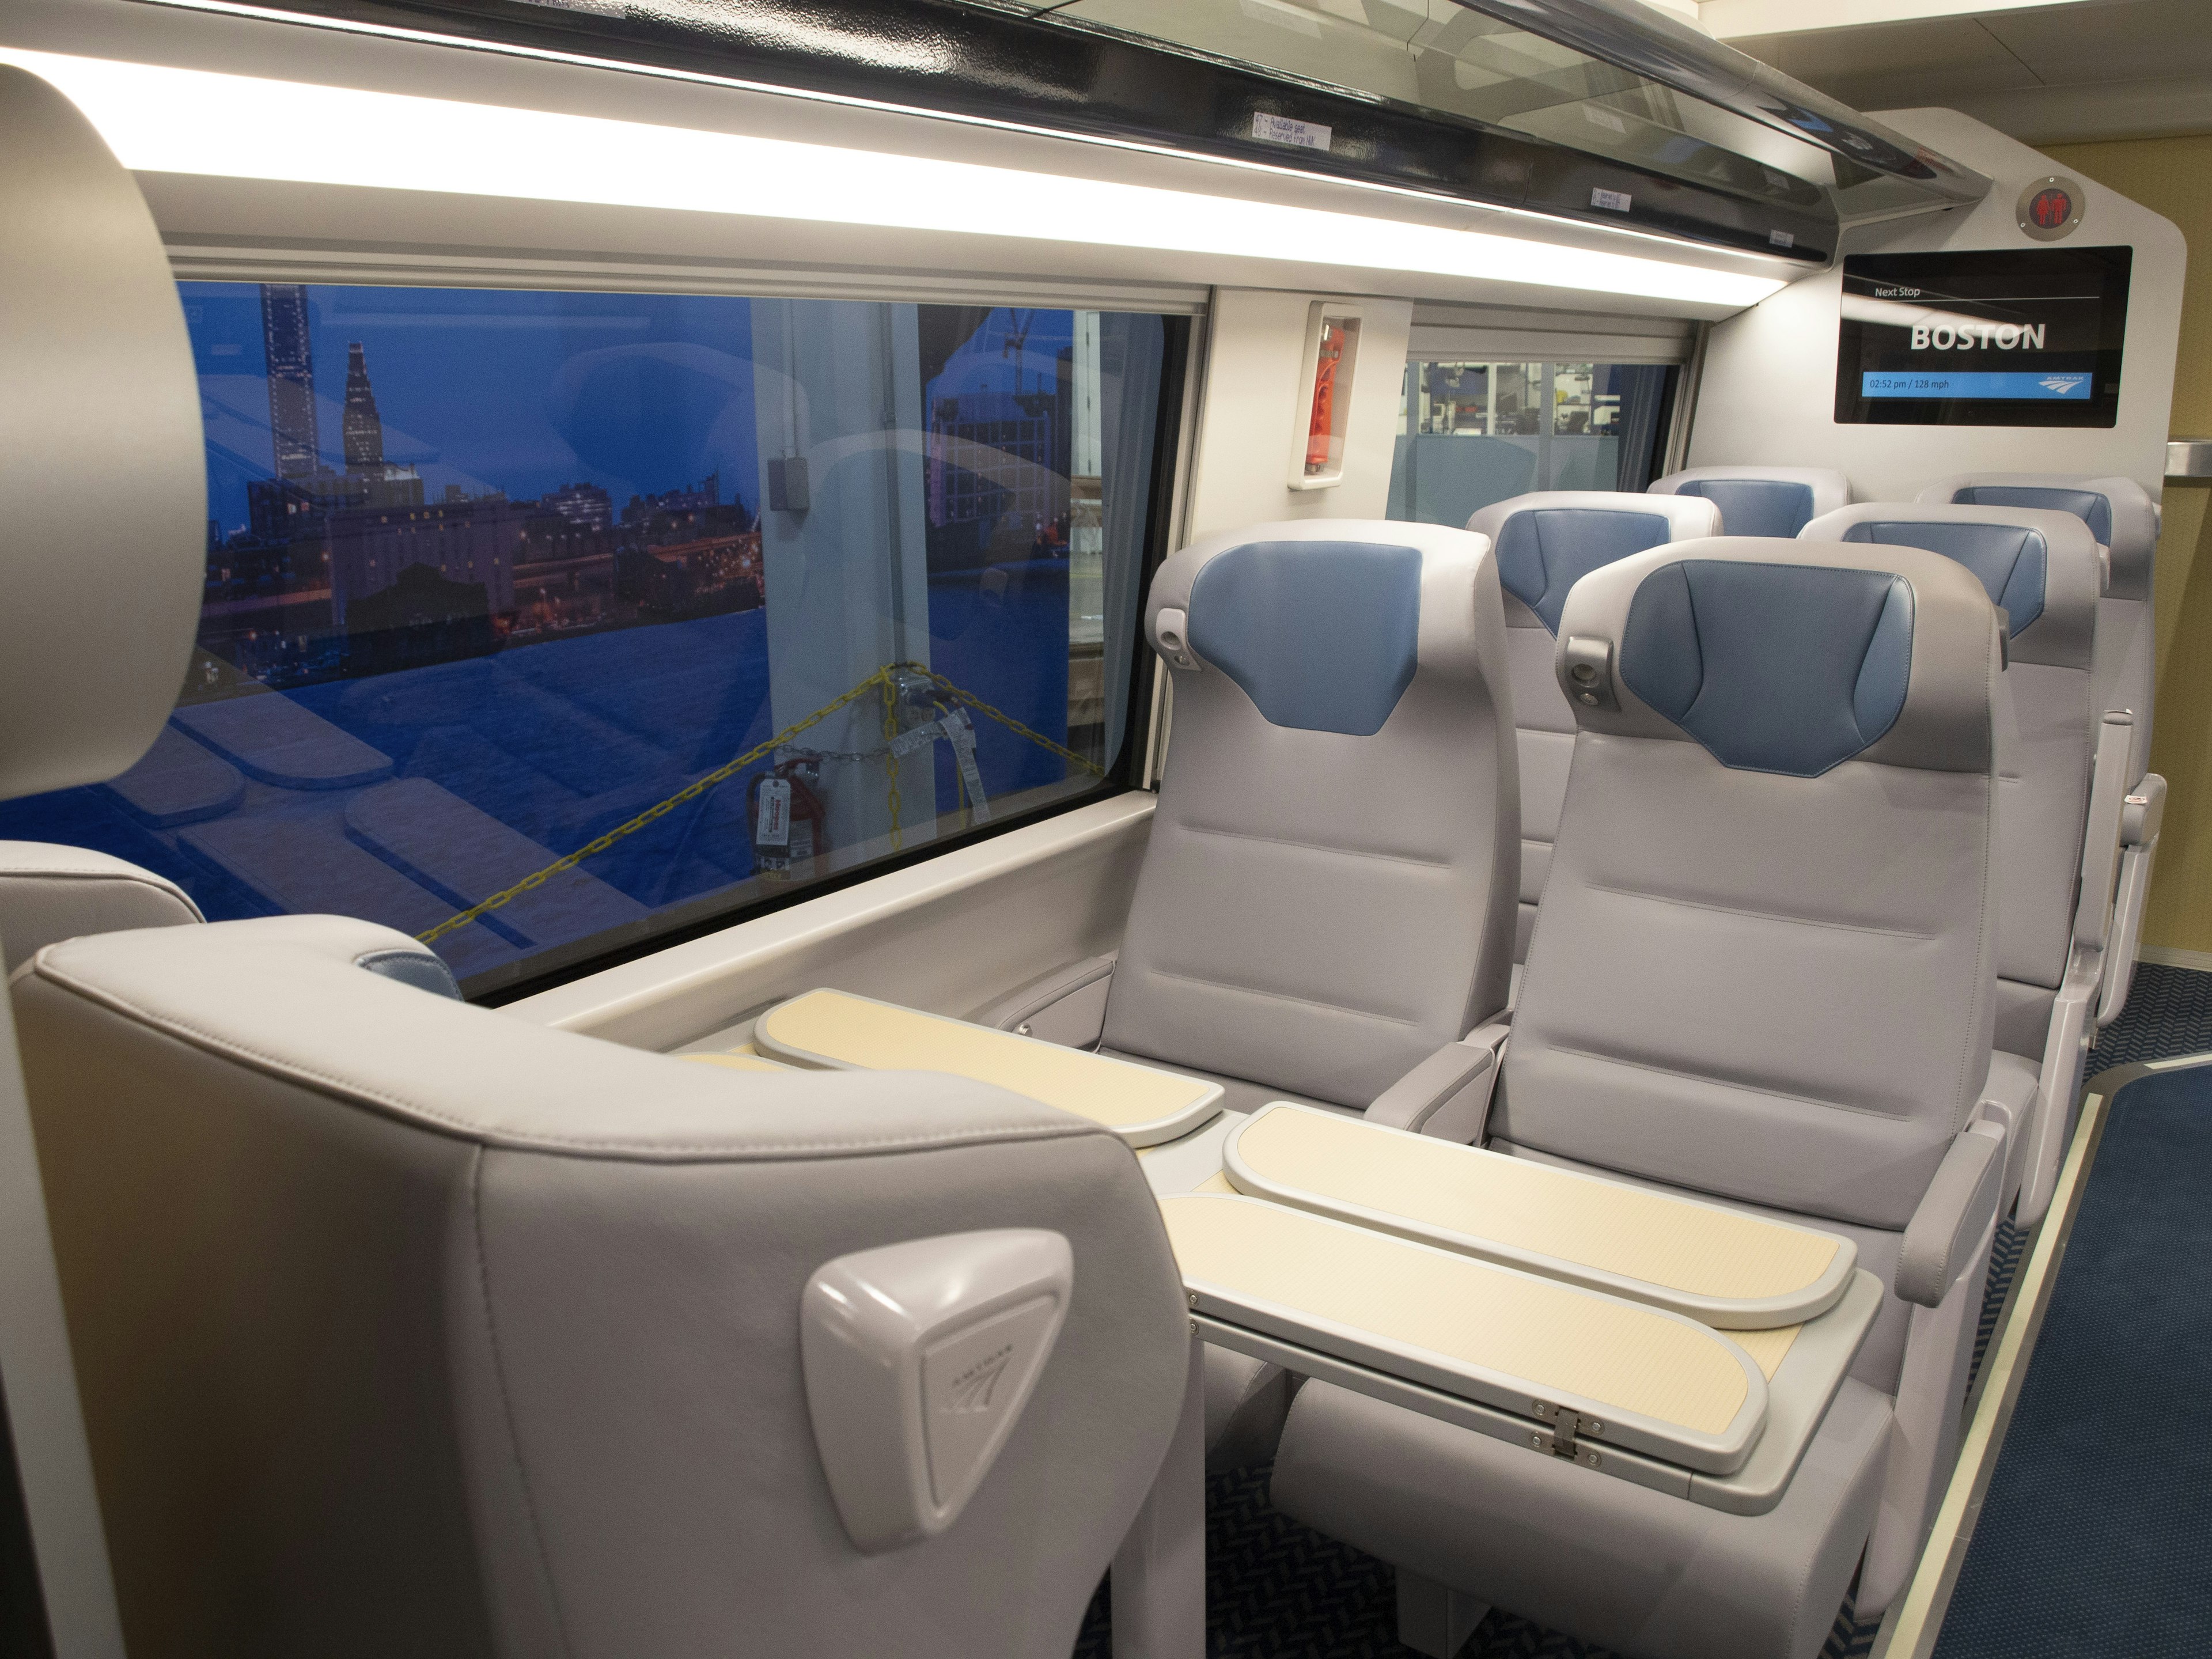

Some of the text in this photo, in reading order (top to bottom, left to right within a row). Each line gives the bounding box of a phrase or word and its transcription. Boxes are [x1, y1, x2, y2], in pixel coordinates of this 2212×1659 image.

[1271, 117, 1293, 131] Available
[1270, 128, 1292, 142] Reserved
[1294, 132, 1305, 145] from
[1875, 287, 1921, 298] Next Stop
[1911, 324, 2046, 350] BOSTON
[1870, 380, 1892, 388] 02:52
[1908, 380, 1913, 389] /
[1915, 380, 1929, 388] 128
[1931, 380, 1949, 390] mph
